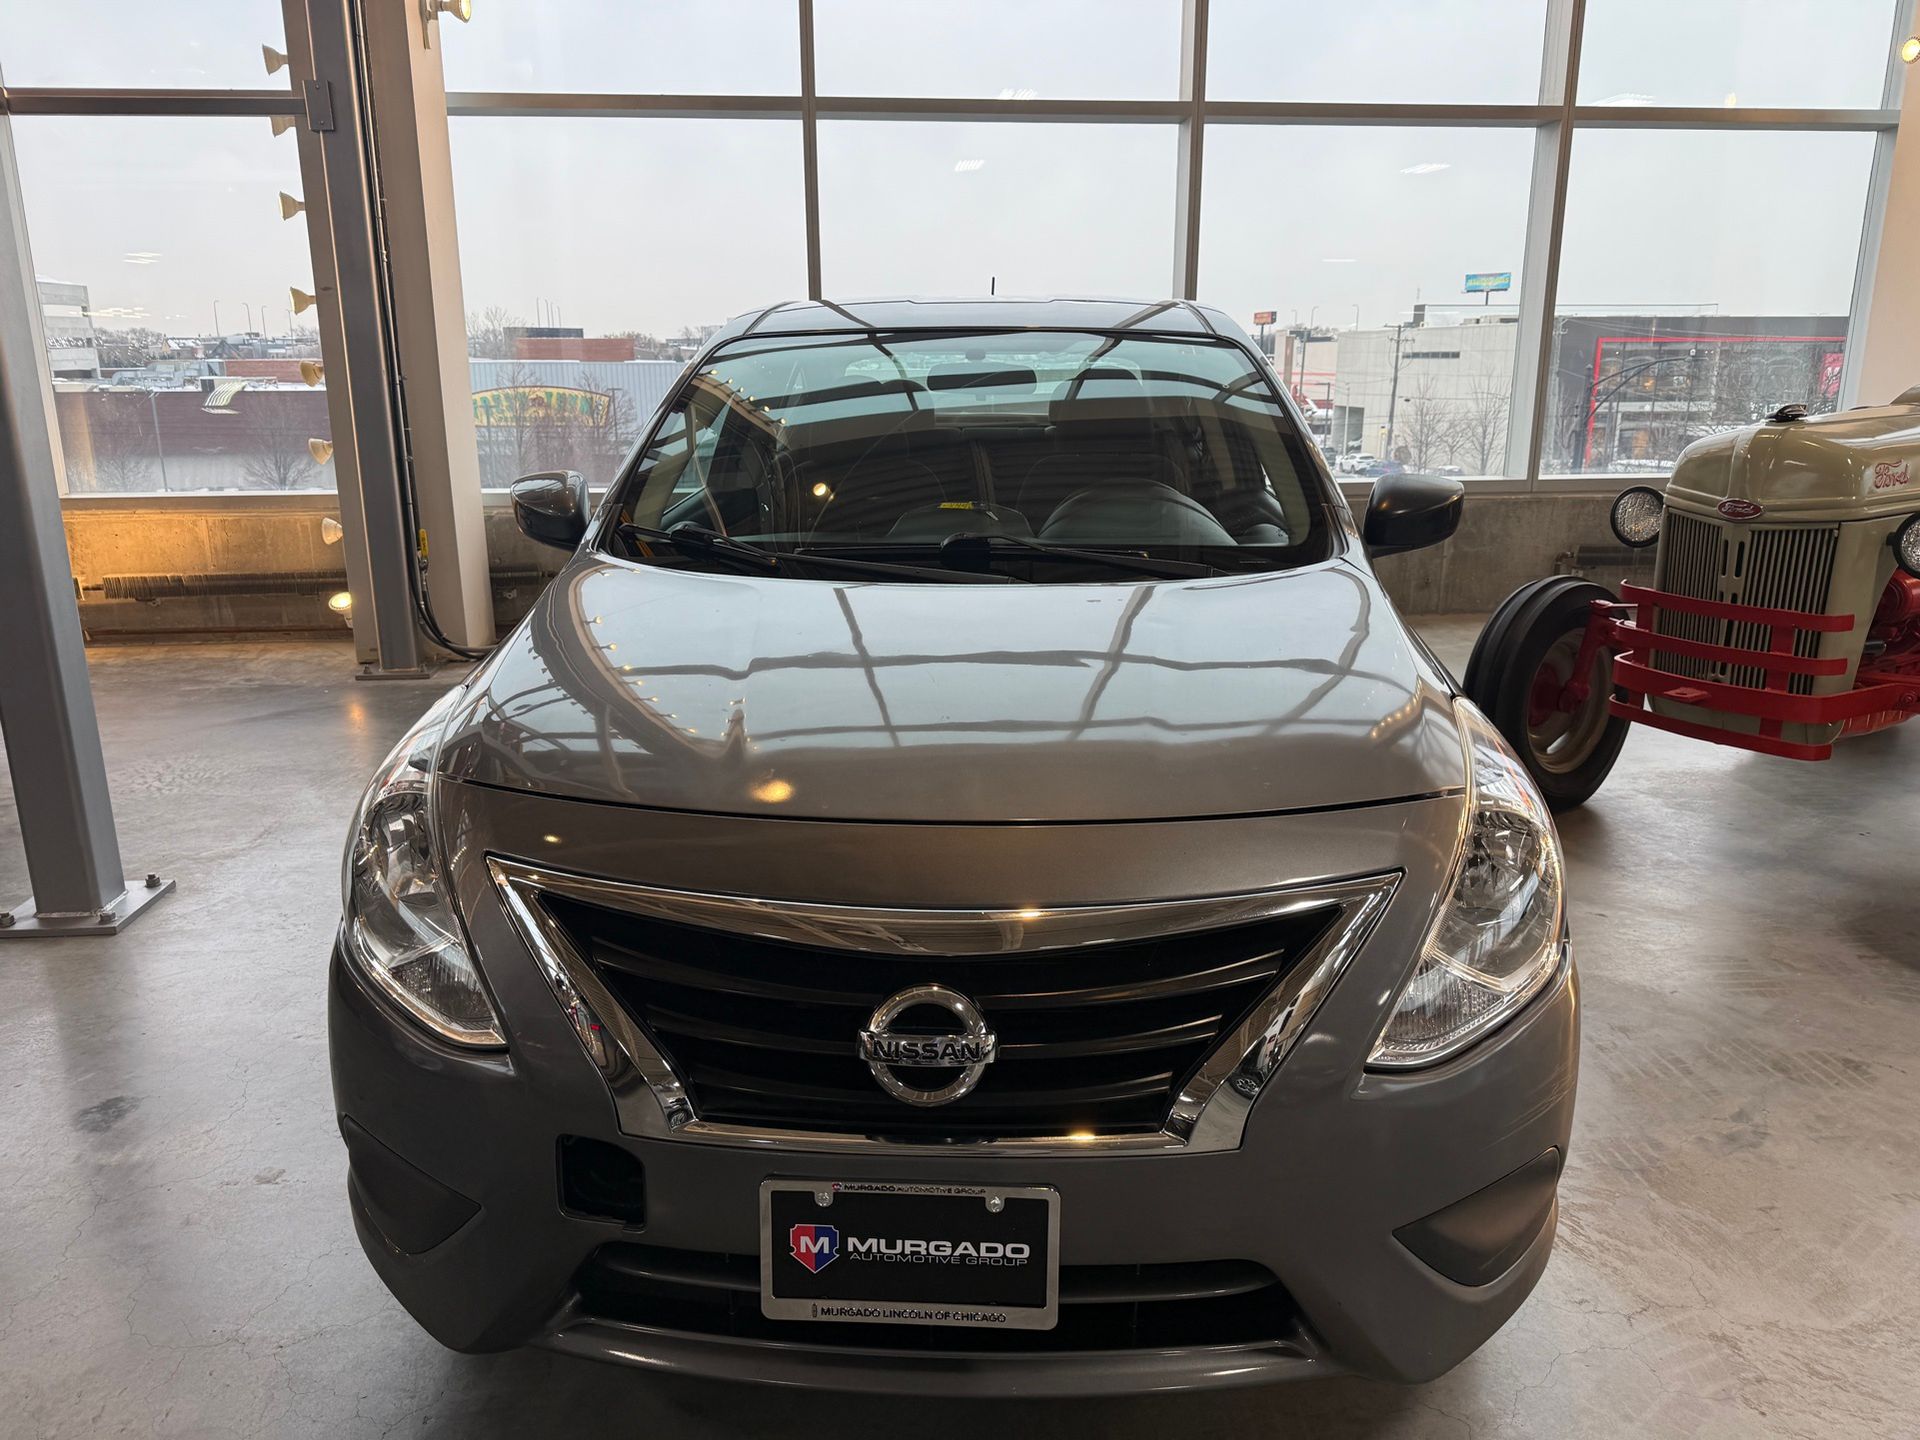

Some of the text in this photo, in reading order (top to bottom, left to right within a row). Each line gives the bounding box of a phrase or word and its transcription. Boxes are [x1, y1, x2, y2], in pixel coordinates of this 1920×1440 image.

[1874, 458, 1909, 489] Ford
[1721, 502, 1754, 513] Ford
[872, 1039, 981, 1061] NISSAN
[844, 1184, 896, 1192] MURGADO
[897, 1186, 952, 1194] AUTOMOTIVE
[799, 1235, 830, 1254] M
[847, 1236, 1031, 1259] MURGADO
[849, 1252, 1028, 1267] AUTOMOTIVE GROUP
[820, 1306, 1006, 1323] MURGADO LINCOLN OF CHICAGO
